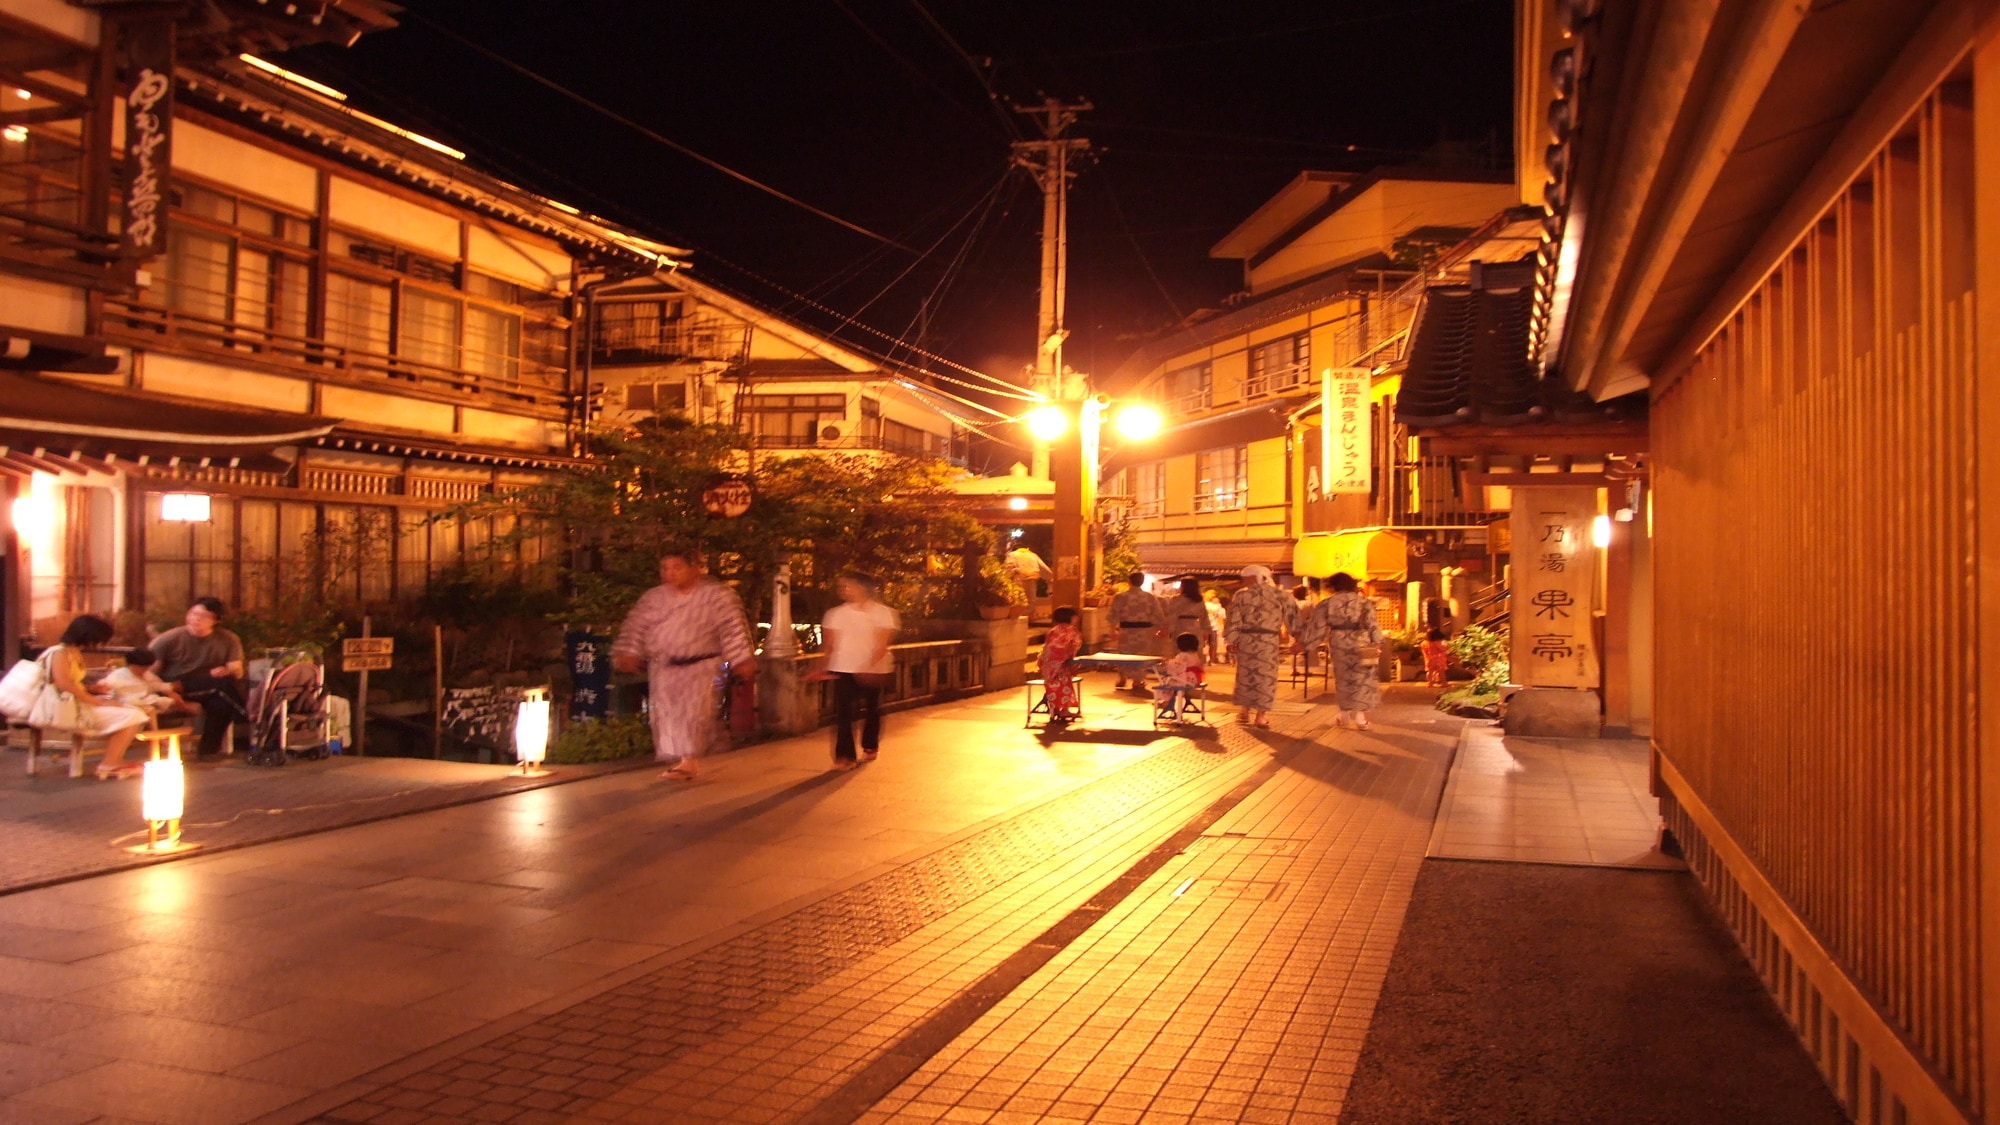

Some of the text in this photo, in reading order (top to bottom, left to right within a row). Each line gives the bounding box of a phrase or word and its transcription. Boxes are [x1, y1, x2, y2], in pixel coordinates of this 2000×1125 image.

[1339, 382, 1361, 477] 温泉まんじゅう
